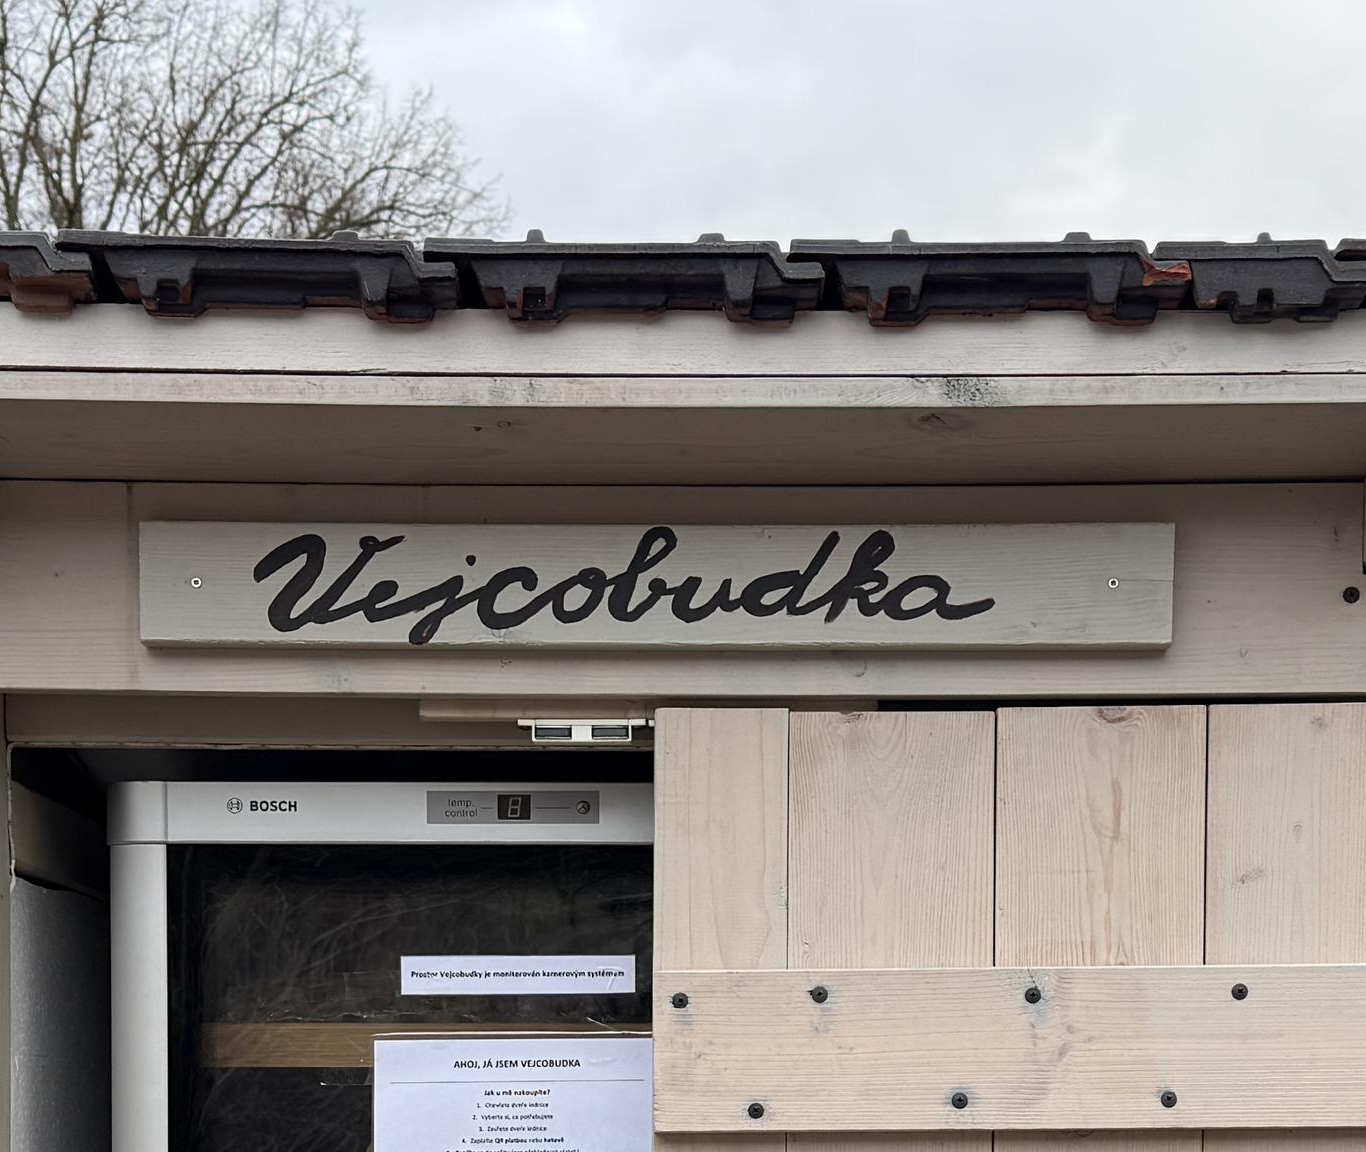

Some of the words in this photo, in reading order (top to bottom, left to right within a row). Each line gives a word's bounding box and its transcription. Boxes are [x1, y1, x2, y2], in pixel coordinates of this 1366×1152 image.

[253, 525, 995, 645] Vejcobudka
[250, 801, 297, 812] BOSCH
[447, 798, 474, 809] temp.
[445, 808, 478, 818] control
[485, 970, 492, 978] je
[454, 1060, 481, 1069] AHOJ,
[483, 1059, 493, 1068] JÁ
[496, 1059, 519, 1068] JSEM
[521, 1058, 581, 1067] VEJCOBUDKA
